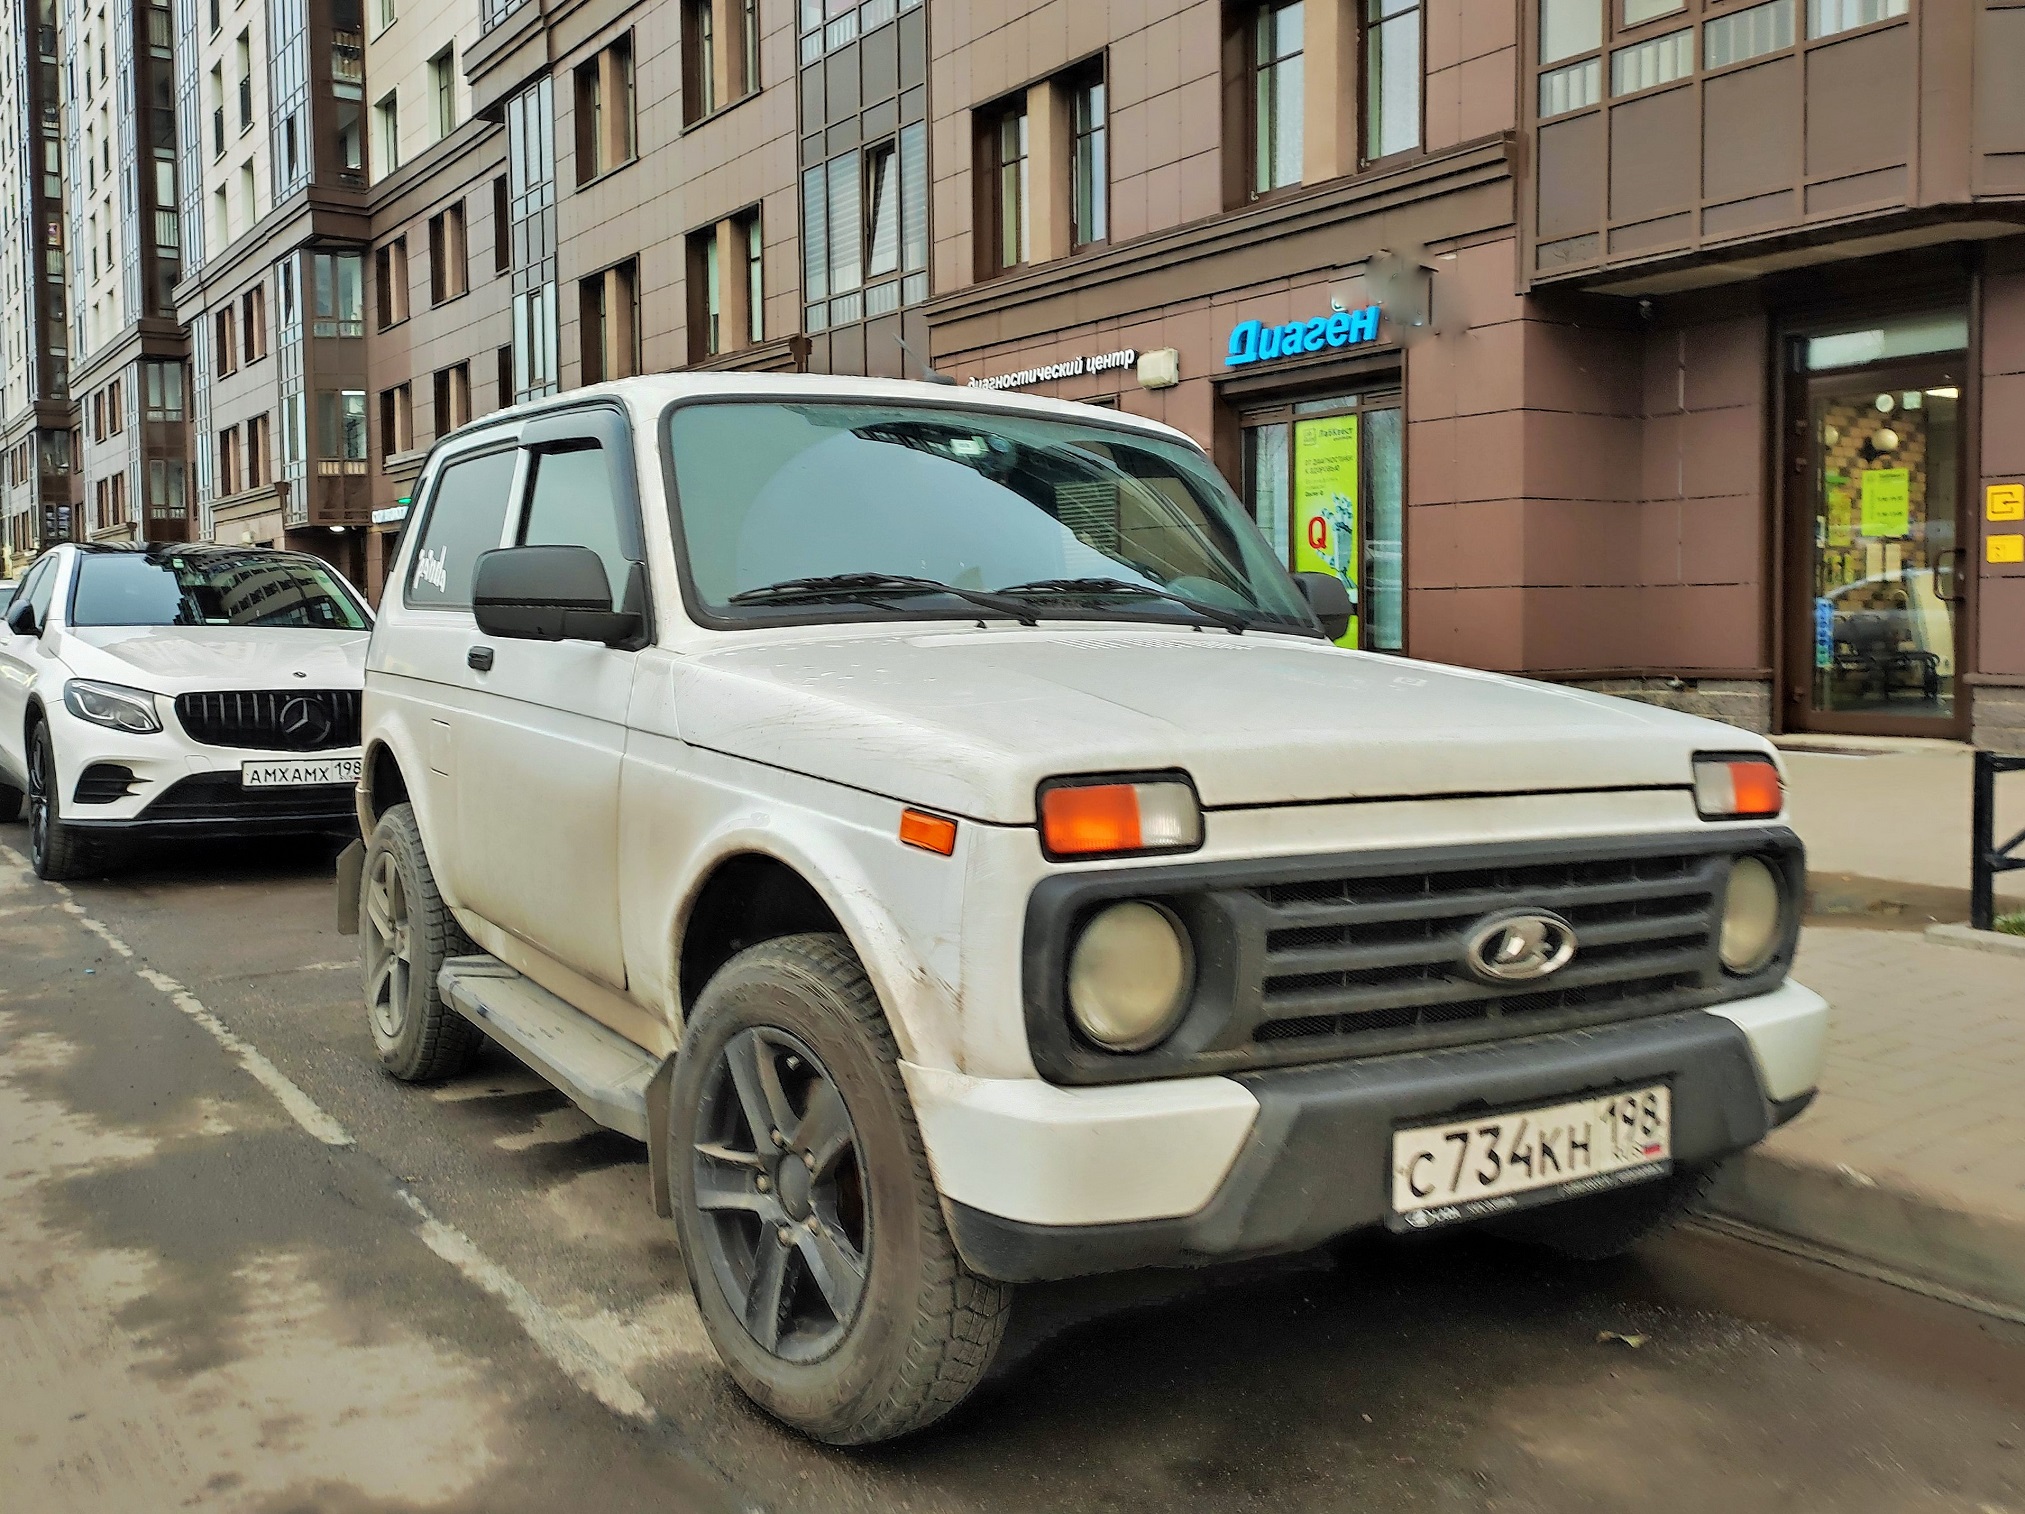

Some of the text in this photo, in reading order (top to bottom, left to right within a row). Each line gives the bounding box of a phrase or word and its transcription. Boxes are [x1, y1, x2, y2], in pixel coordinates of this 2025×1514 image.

[1224, 305, 1381, 367] Диаген
[1086, 348, 1136, 375] центр
[1308, 516, 1327, 549] Q
[334, 761, 361, 777] 198
